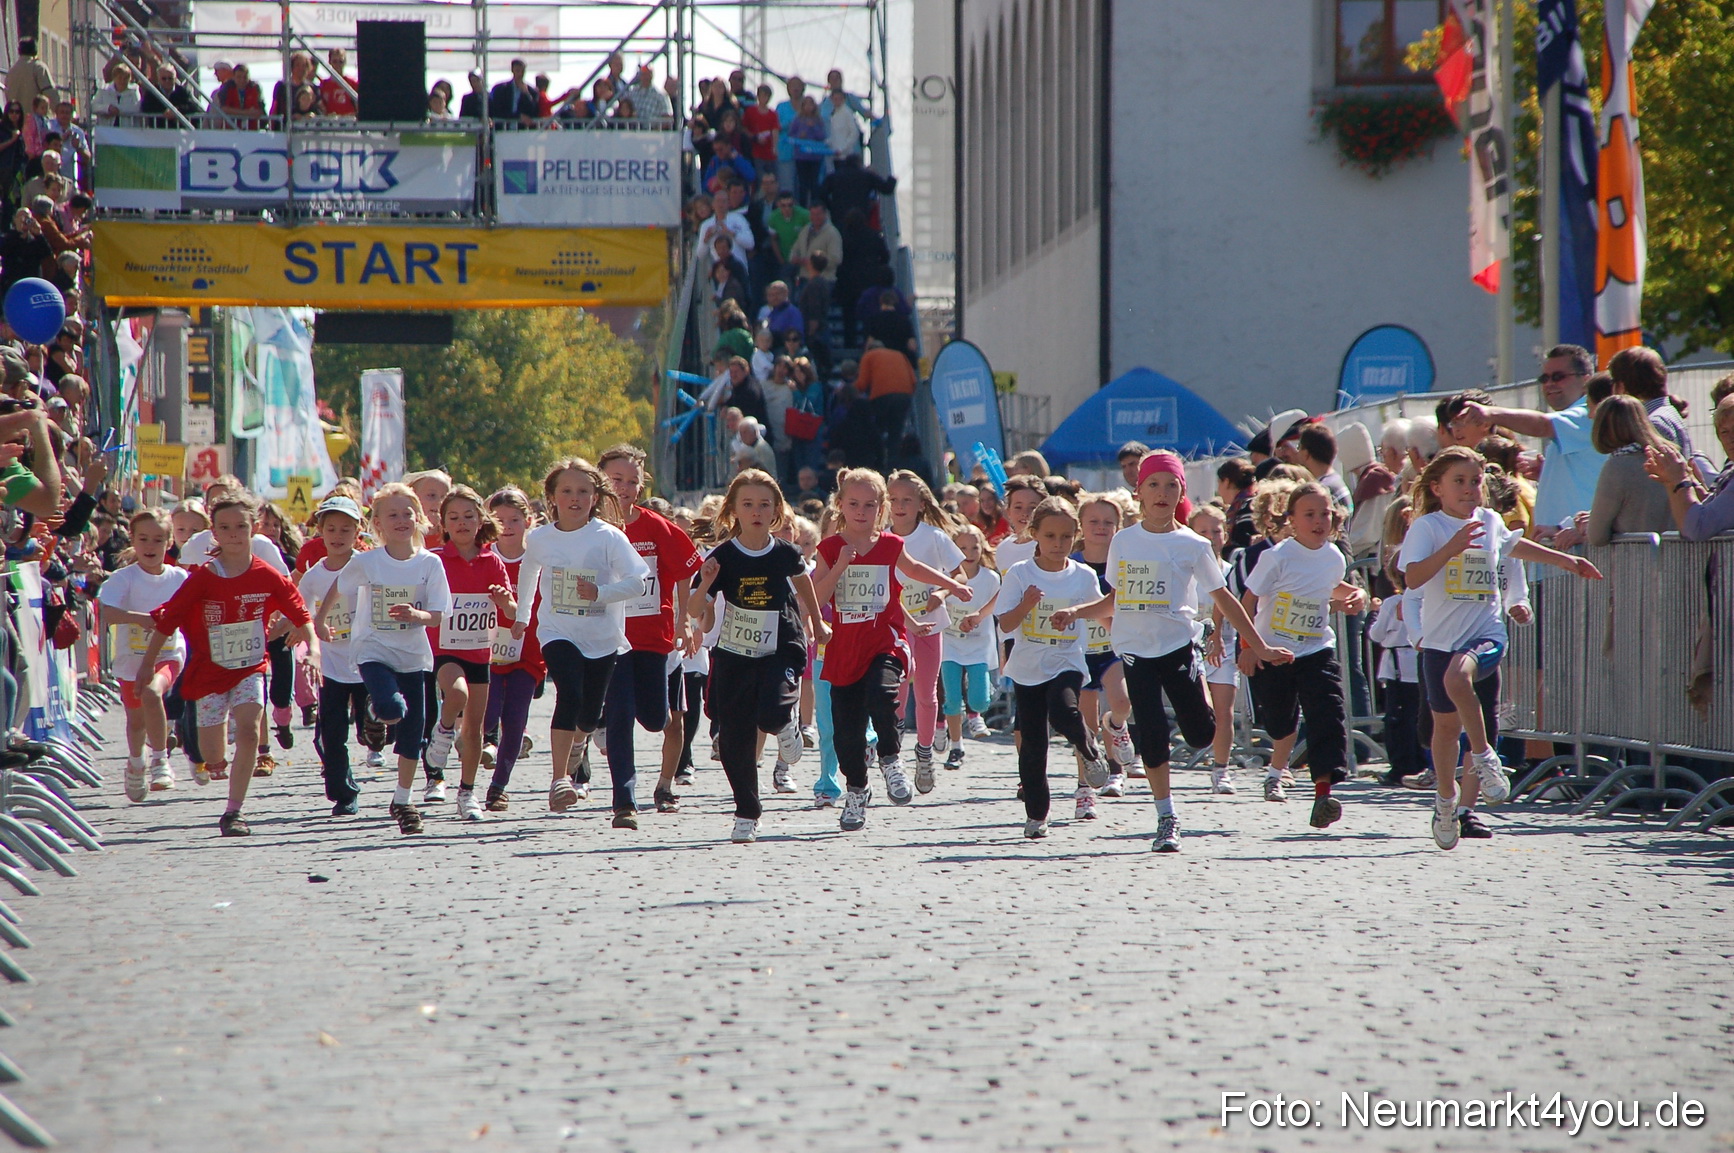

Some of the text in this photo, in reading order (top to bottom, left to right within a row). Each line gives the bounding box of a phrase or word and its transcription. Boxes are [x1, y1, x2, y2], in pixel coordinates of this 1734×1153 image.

[182, 148, 398, 192] BOCK
[543, 160, 669, 181] PFLEIDERER
[543, 184, 670, 195] AKTIENGESELLSCHAFT
[124, 262, 249, 274] Neumarkter Stadtlauf
[284, 241, 478, 284] START
[515, 265, 636, 277] Neumarkter Stadtlauf
[292, 486, 306, 505] A
[847, 568, 870, 578] Laura
[1127, 564, 1149, 574] Sarah
[385, 588, 408, 598] Sarah
[849, 583, 885, 597] 7040
[1127, 580, 1166, 595] 7125
[453, 597, 488, 609] Lena
[1038, 602, 1053, 611] Lisa
[327, 609, 356, 626] 713
[449, 612, 496, 631] 10206
[734, 612, 758, 625] Selina
[1290, 612, 1324, 629] 7192
[735, 626, 773, 644] 7087
[227, 637, 261, 654] 7183
